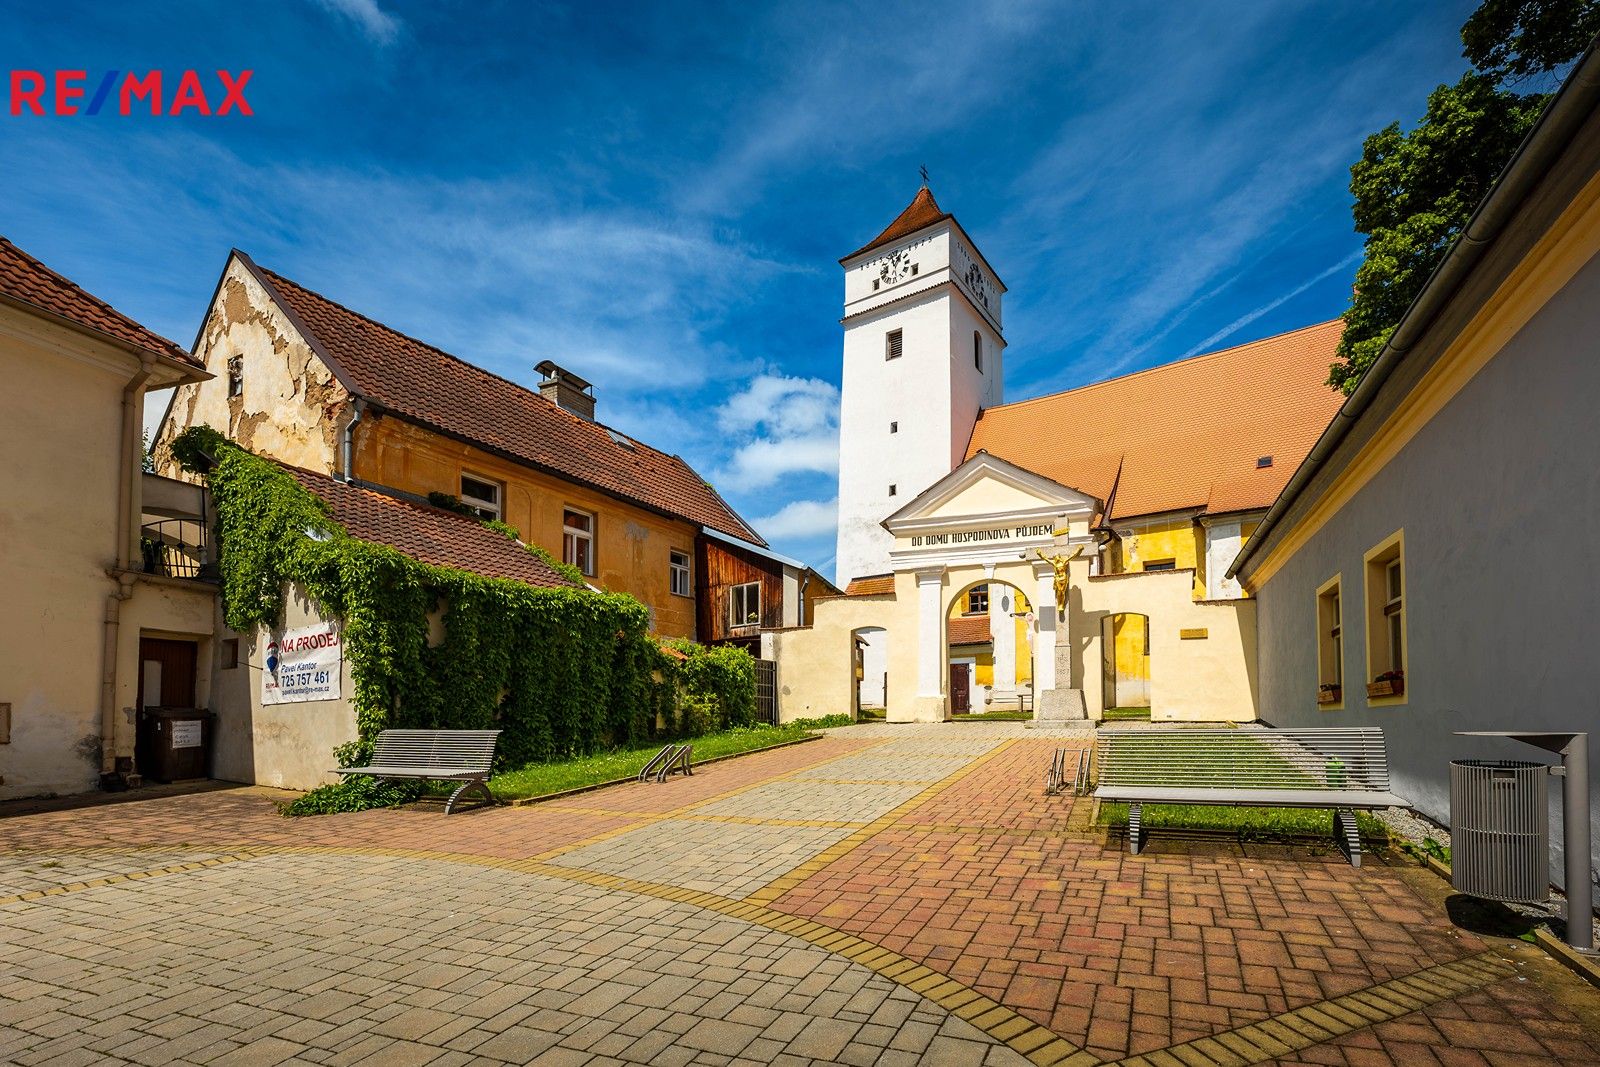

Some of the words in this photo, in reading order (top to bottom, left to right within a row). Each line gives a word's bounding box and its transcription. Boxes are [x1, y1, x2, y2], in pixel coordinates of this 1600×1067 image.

[912, 536, 922, 546] DO
[926, 533, 948, 546] DOMU
[952, 528, 1010, 543] HOSPODINOVA
[281, 639, 294, 653] NA
[296, 632, 339, 651] PRODEJ
[281, 664, 296, 673] Pavel
[297, 662, 317, 671] Kantor
[281, 675, 295, 688] 725
[297, 672, 311, 686] 757
[314, 671, 329, 684] 461
